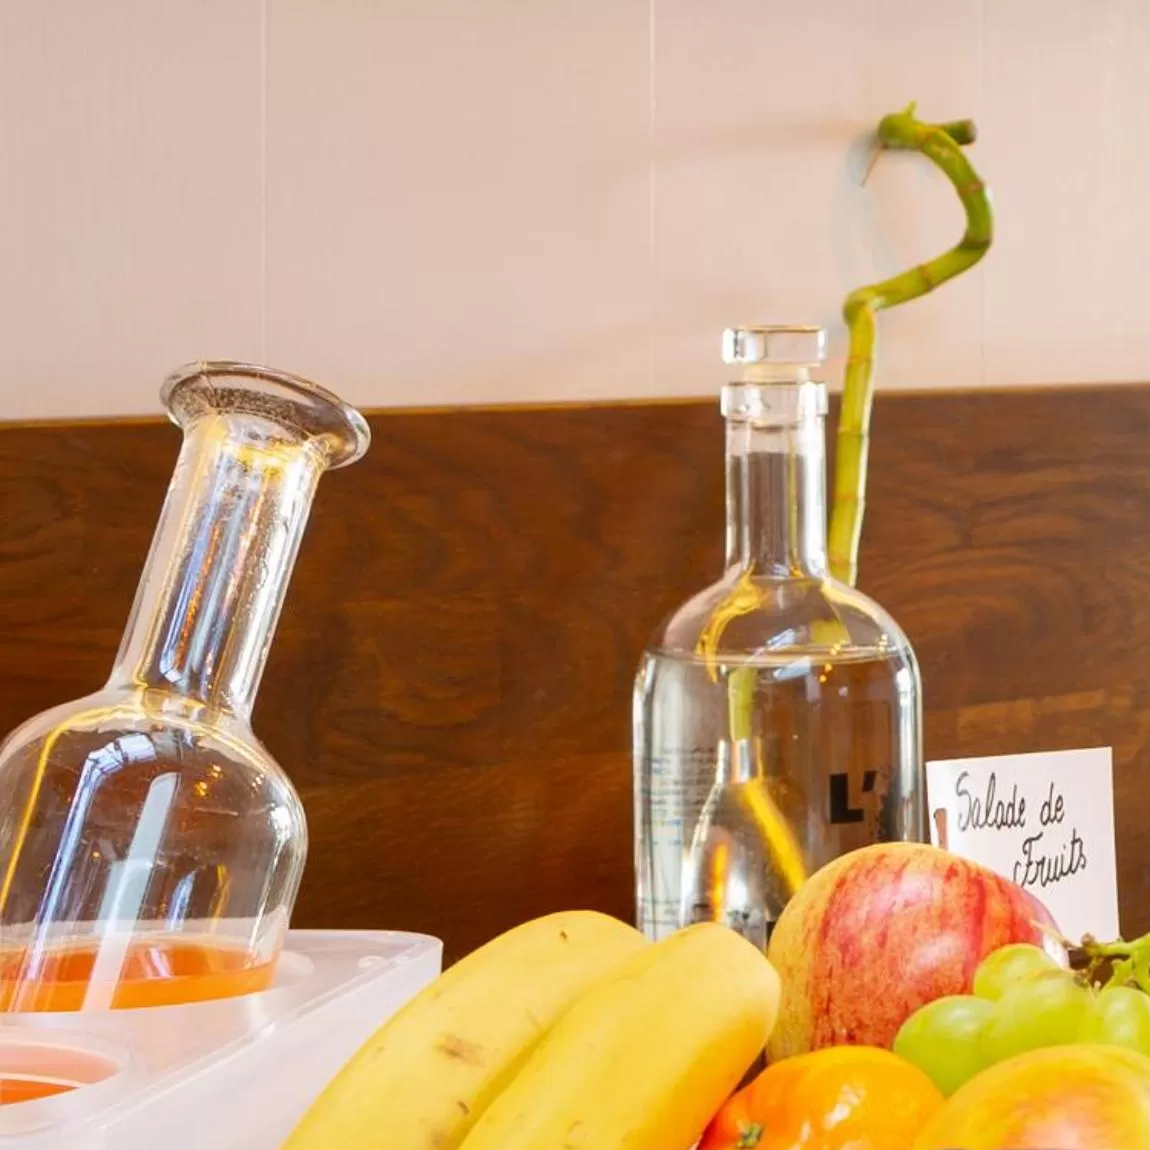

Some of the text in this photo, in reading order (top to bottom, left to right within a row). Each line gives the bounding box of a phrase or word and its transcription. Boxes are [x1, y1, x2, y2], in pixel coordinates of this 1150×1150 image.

[955, 770, 1066, 832] Salade de
[1013, 828, 1087, 888] Fruits
